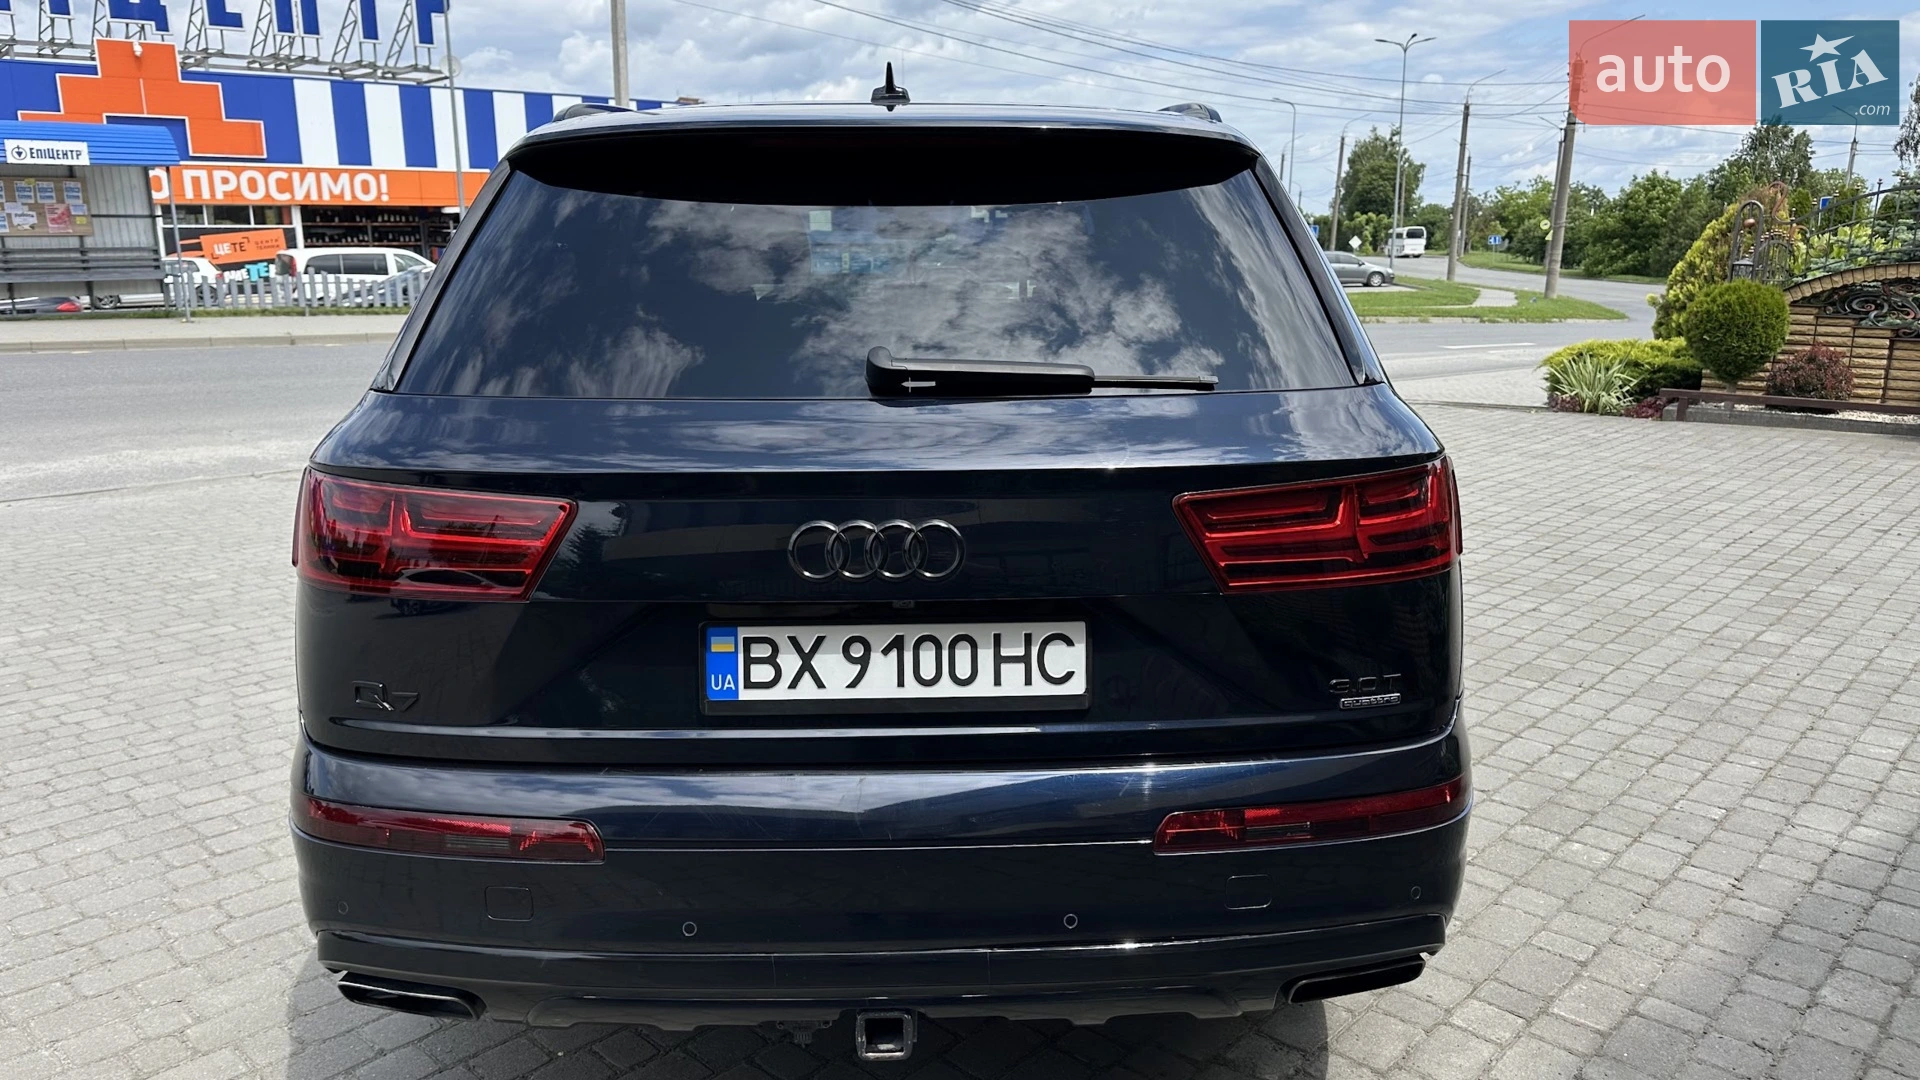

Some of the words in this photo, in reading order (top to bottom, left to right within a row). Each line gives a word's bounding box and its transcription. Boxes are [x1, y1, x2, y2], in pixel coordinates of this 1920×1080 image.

[182, 169, 390, 202] ПРОСИМО!
[213, 241, 246, 255] ЦЕТЕ
[742, 635, 827, 689] BX
[841, 633, 979, 689] 9100
[992, 632, 1075, 687] HC
[711, 674, 736, 691] UA
[352, 680, 420, 711] Q7
[1343, 696, 1399, 708] quattro
